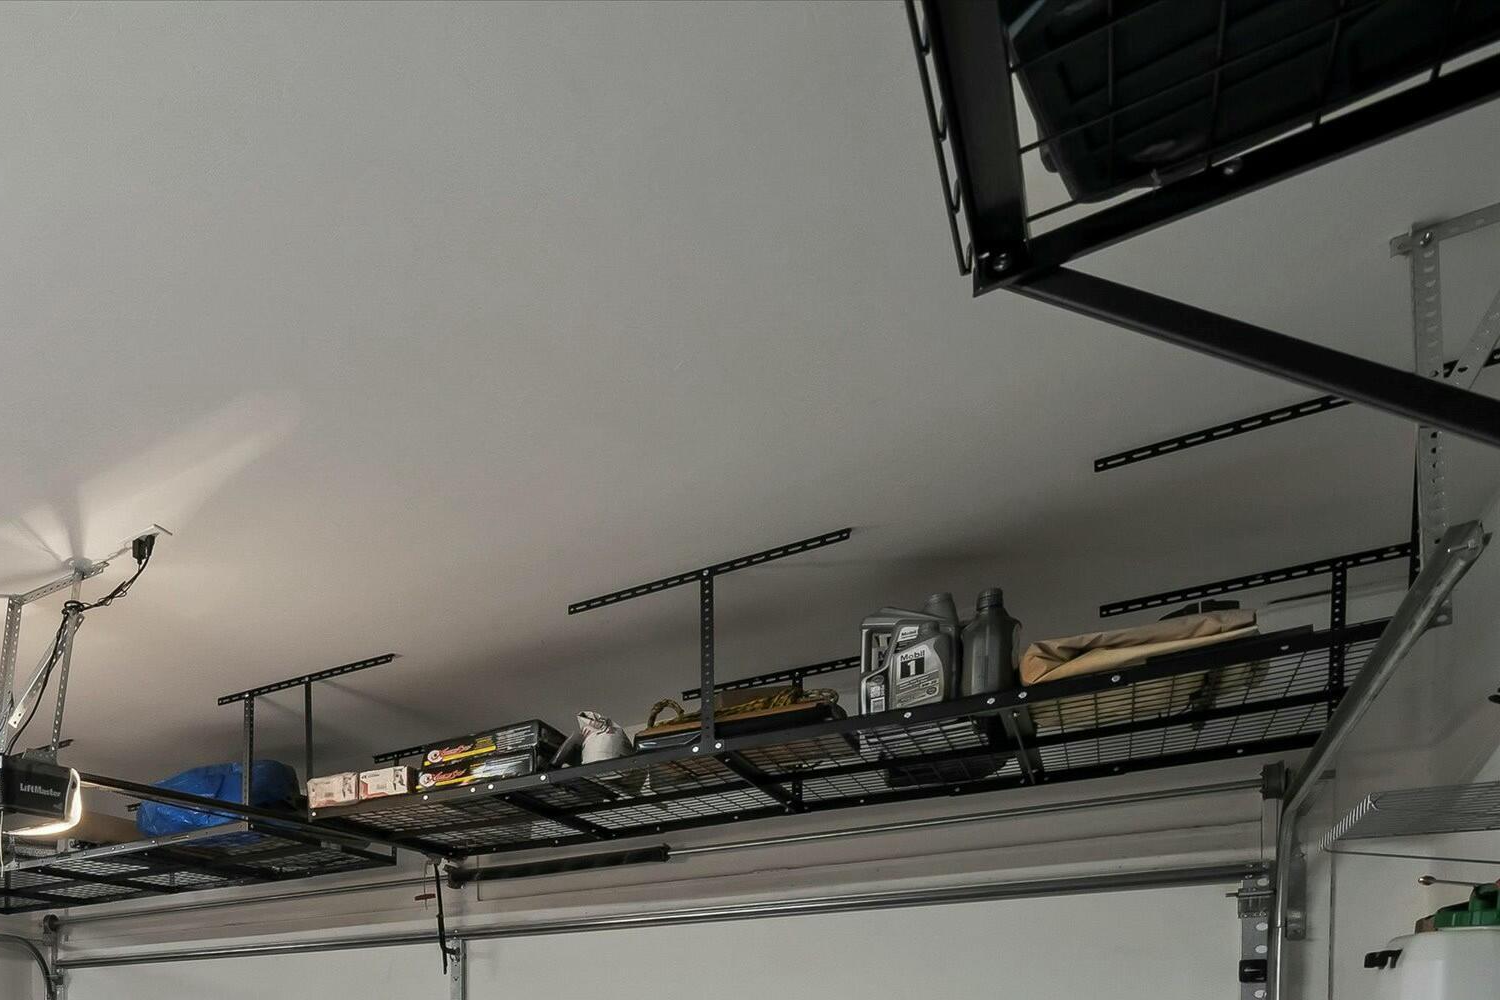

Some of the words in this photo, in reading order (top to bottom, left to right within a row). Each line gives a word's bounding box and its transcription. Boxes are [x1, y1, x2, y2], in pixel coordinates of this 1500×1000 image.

[900, 649, 926, 662] Mobil
[907, 660, 916, 676] 1
[19, 783, 62, 797] LiftMaster
